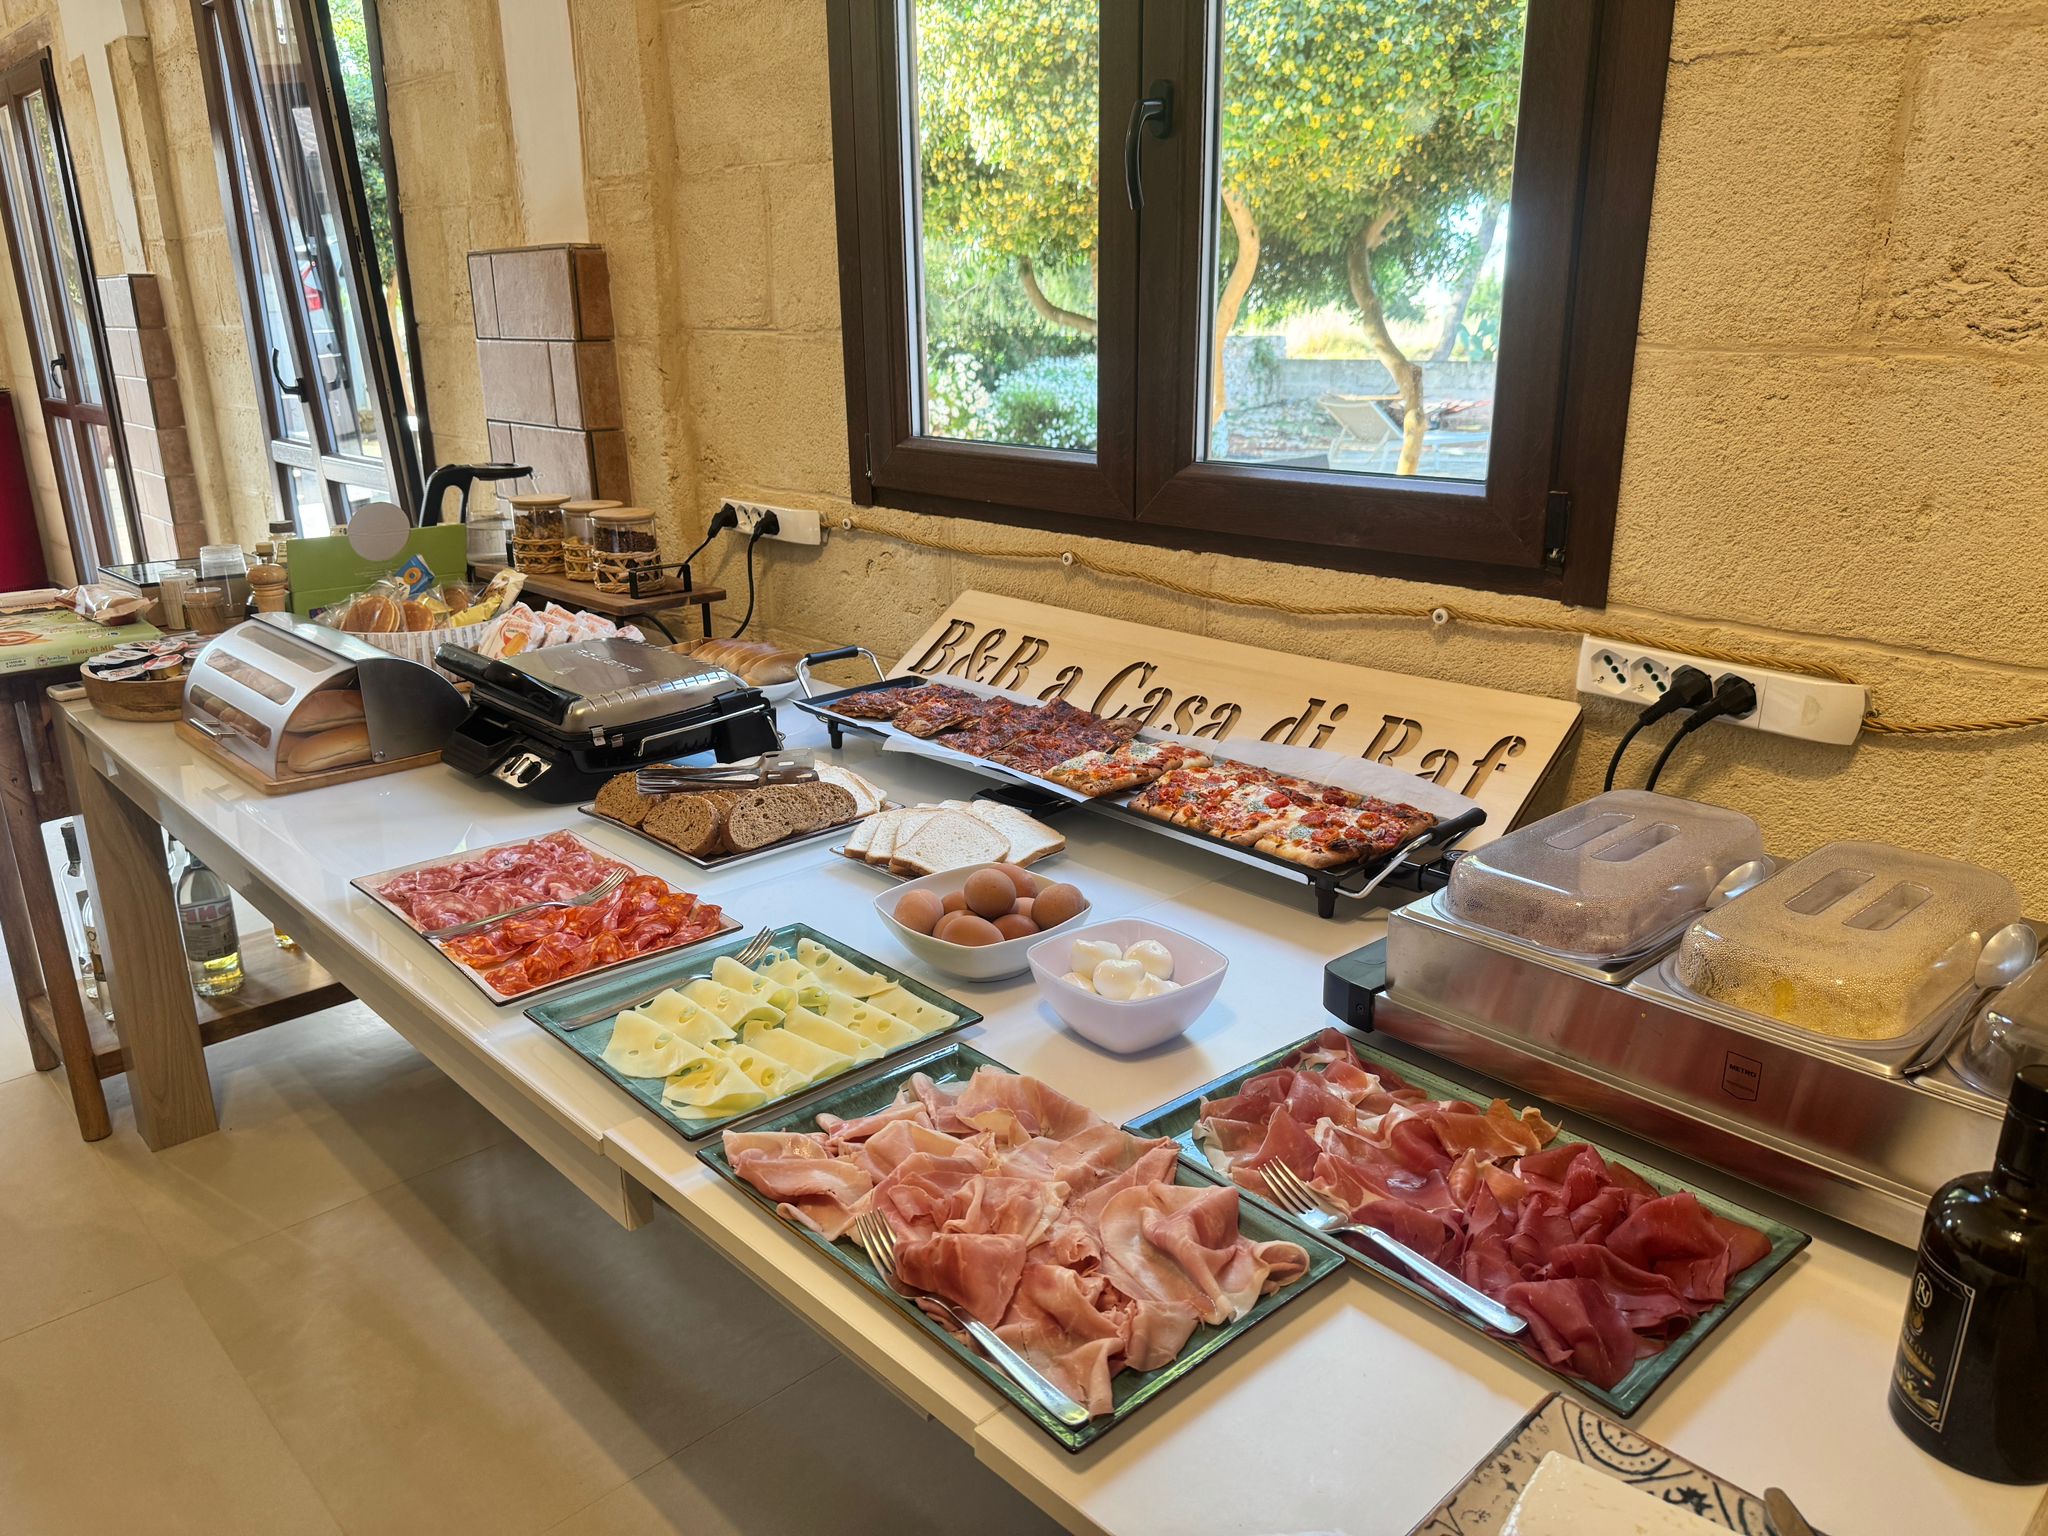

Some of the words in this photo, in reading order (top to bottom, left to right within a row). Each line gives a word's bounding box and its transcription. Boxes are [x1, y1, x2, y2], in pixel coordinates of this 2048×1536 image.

[907, 618, 1050, 692] B&B
[1037, 665, 1084, 702] a
[1090, 661, 1243, 742] Casa
[1259, 697, 1349, 750] di
[1360, 714, 1527, 799] Raf
[1729, 1063, 1758, 1078] METRO
